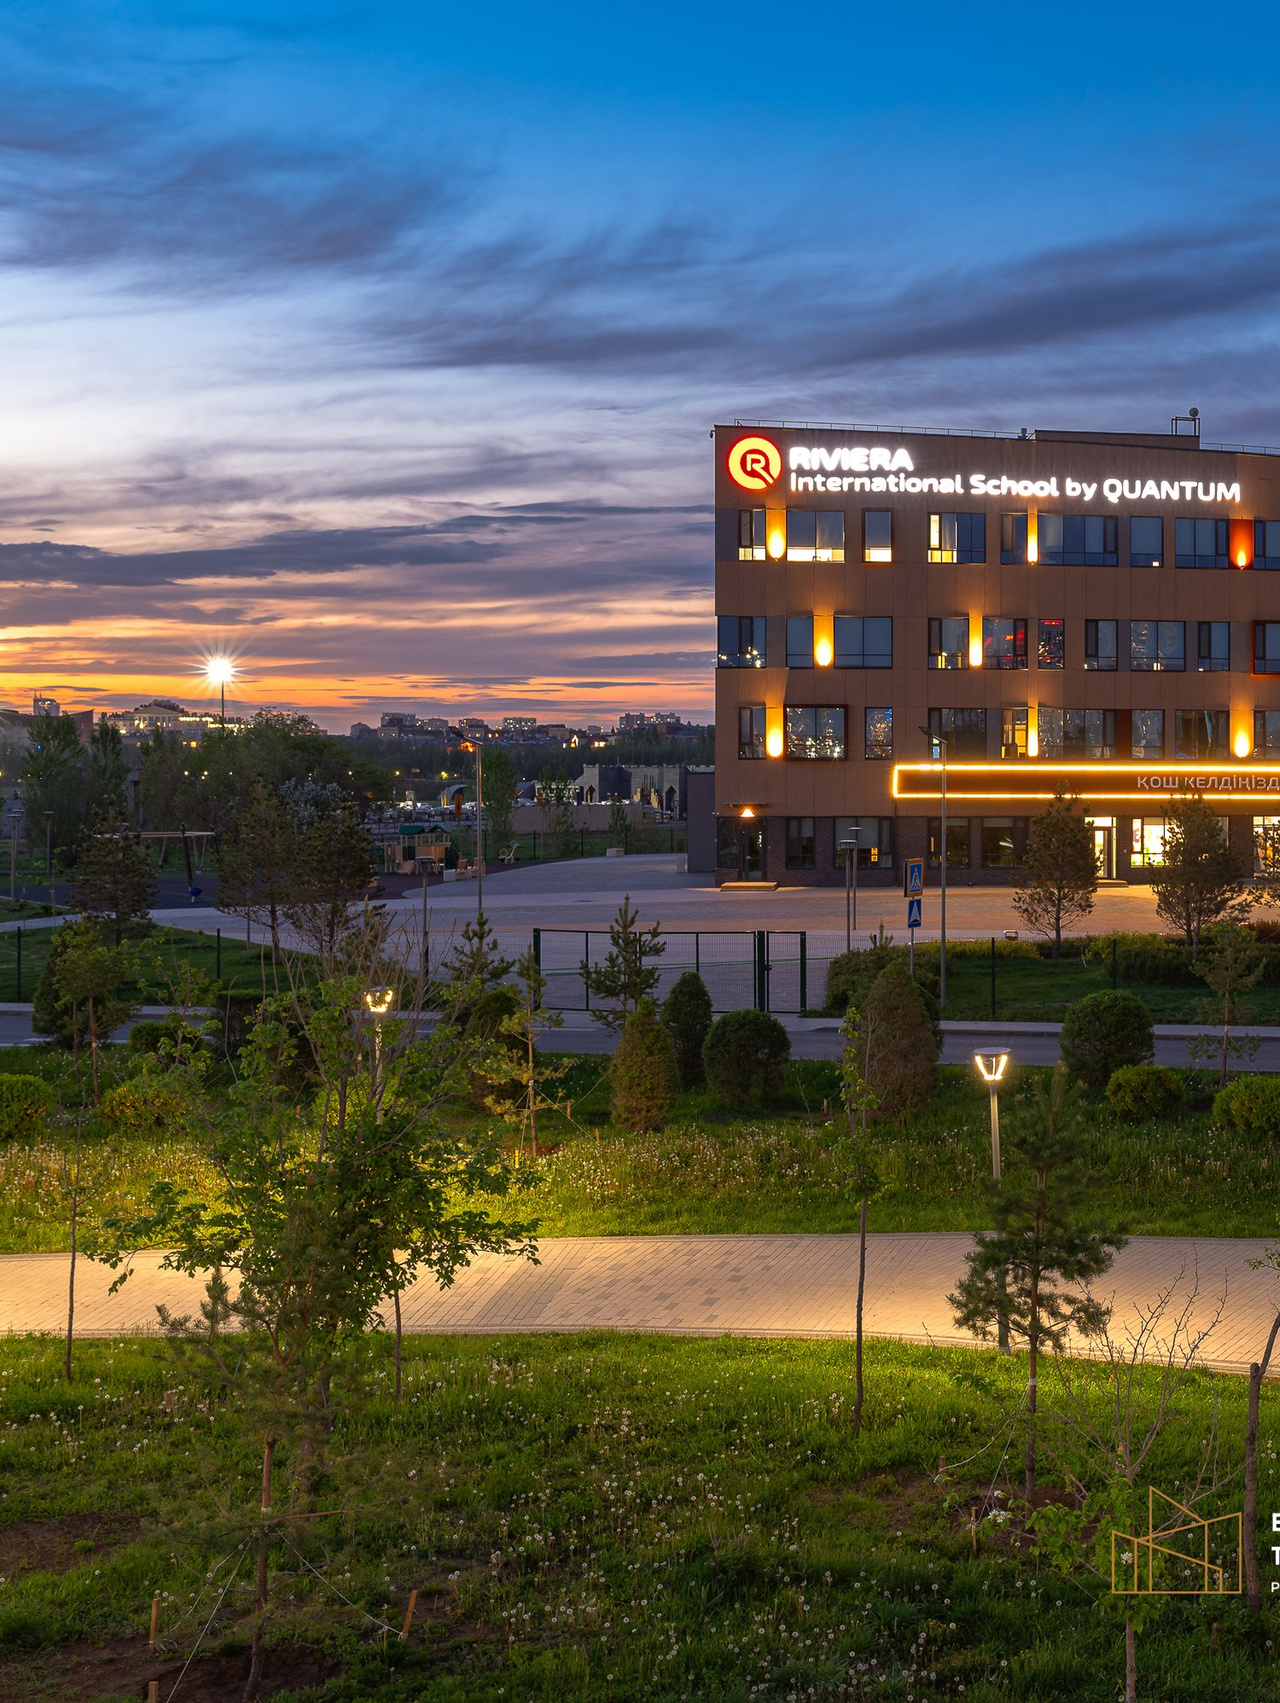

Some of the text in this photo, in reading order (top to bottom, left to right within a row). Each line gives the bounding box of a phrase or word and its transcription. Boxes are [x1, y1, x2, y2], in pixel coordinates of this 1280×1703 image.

[789, 446, 914, 471] RIVIERA
[790, 472, 1241, 503] International School by QUANTUM
